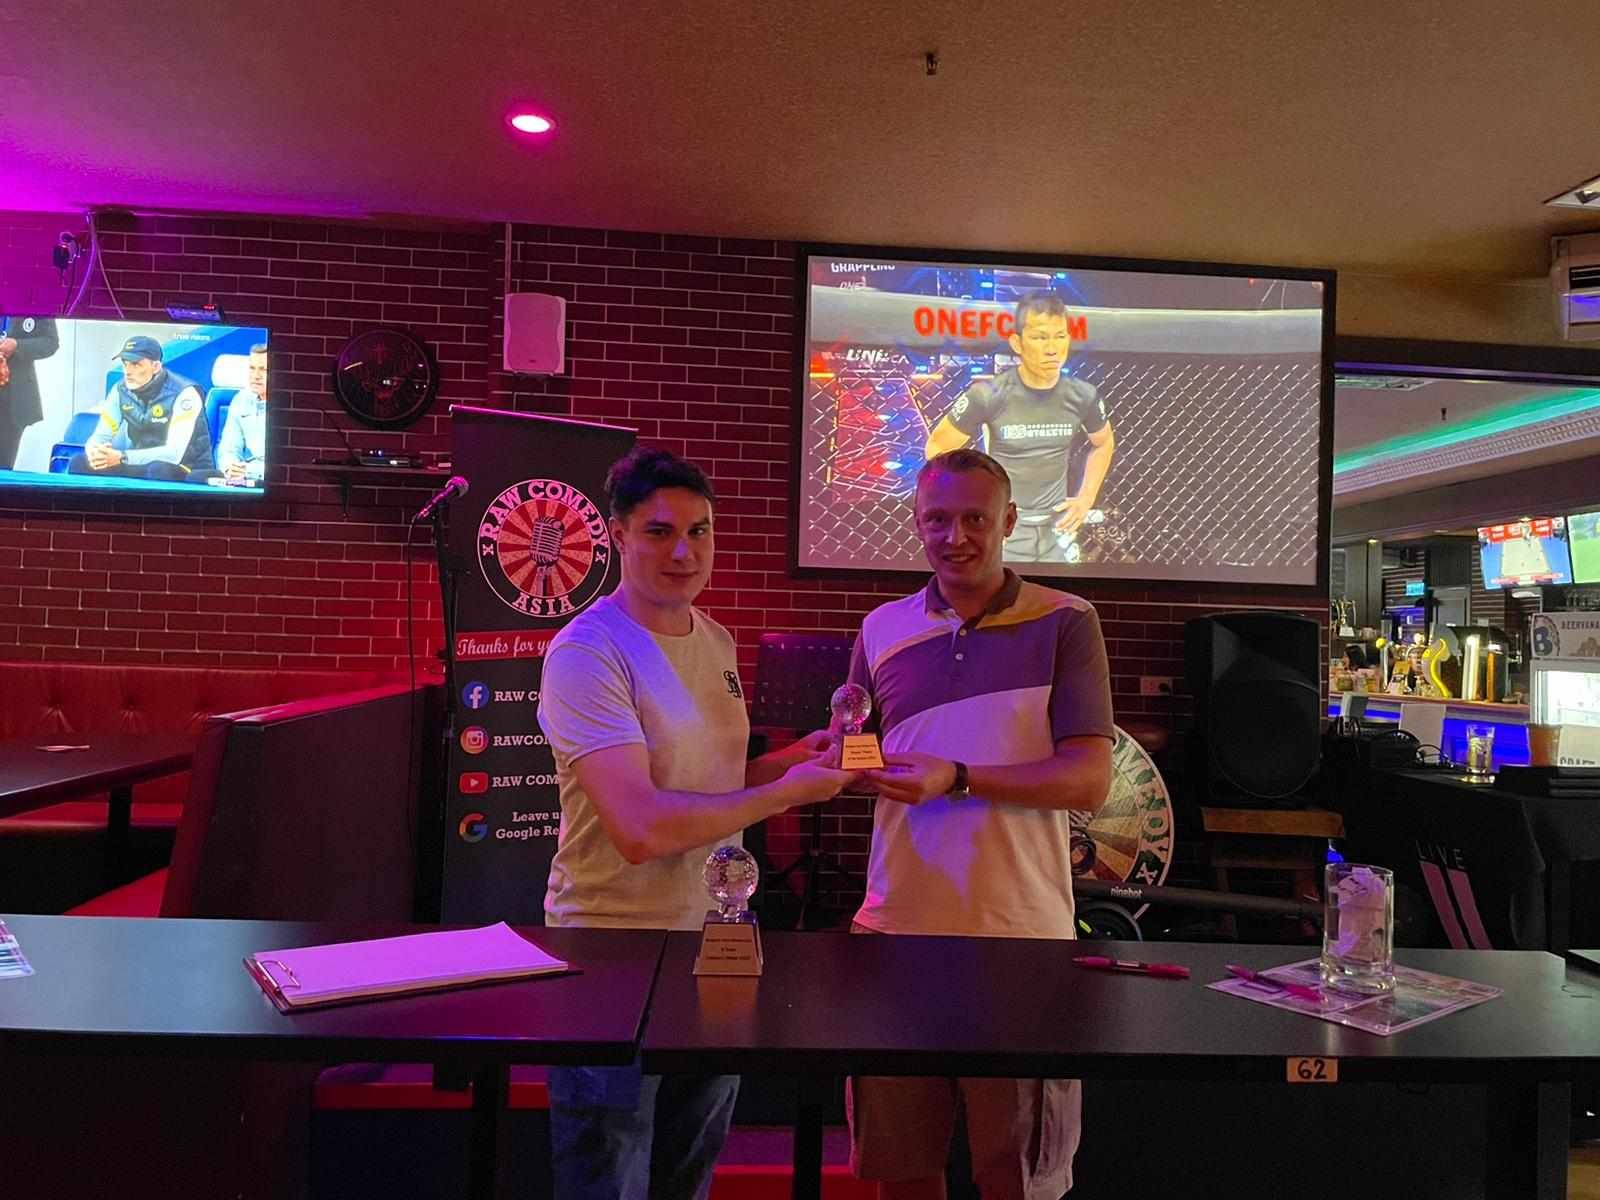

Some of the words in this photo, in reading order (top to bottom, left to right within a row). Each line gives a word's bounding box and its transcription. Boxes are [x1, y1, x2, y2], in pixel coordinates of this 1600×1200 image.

[480, 487, 523, 541] RAW
[528, 481, 610, 548] COMEDY
[513, 594, 575, 616] ASIA
[457, 638, 509, 656] Thanks
[513, 635, 534, 658] for
[494, 691, 525, 702] RAW
[492, 776, 523, 788] RAW
[512, 811, 550, 822] Leave
[495, 827, 541, 840] Google
[1297, 1059, 1327, 1080] 62
